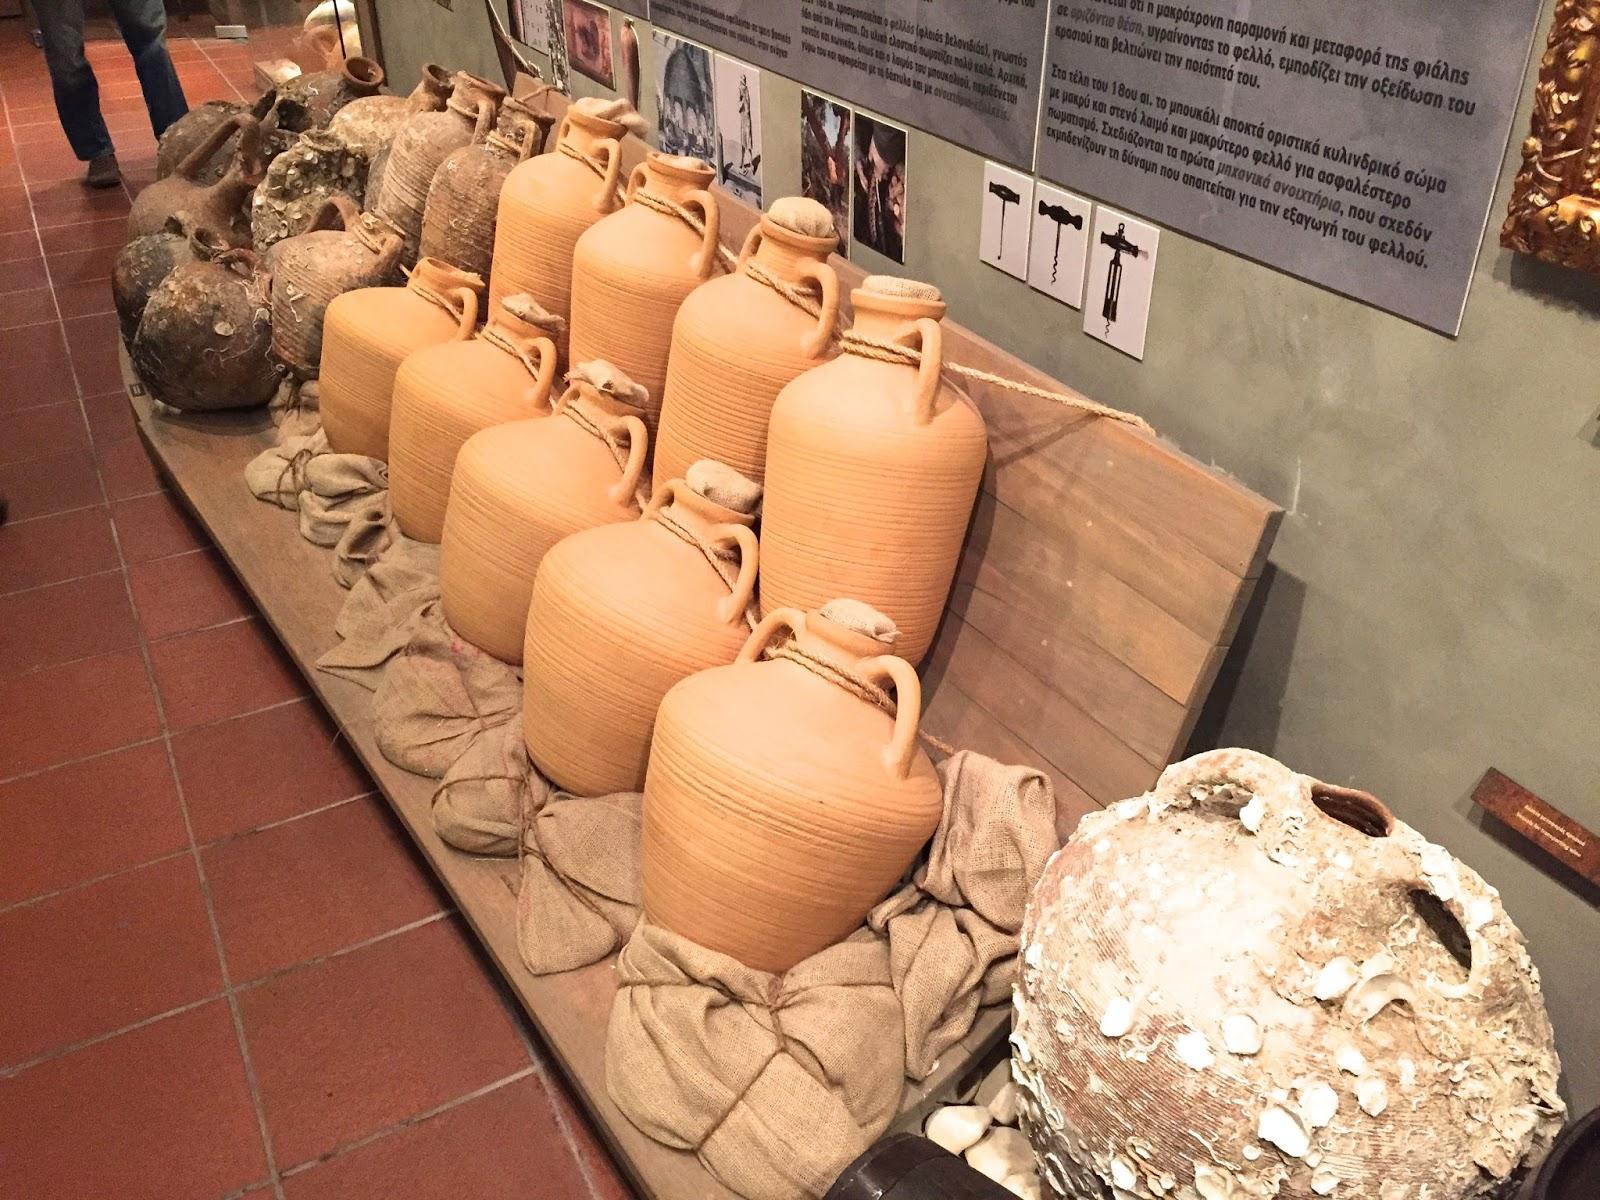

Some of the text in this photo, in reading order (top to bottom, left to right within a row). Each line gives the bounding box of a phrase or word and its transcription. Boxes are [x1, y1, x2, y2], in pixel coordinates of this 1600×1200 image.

[992, 48, 1028, 68] γνωστός
[1055, 25, 1260, 88] κρασιού και βελτιώνει την ποιότητά του.
[1057, 4, 1069, 17] σε
[1070, 8, 1115, 29] οριζόντια
[1117, 16, 1144, 37] θέση,
[1147, 25, 1214, 52] υγραίνοντας
[1217, 42, 1230, 56] το
[1233, 45, 1275, 68] φελλό,
[1279, 55, 1340, 83] εμποδίζει
[1344, 72, 1368, 90] την
[1372, 78, 1444, 108] οξείδωση
[1448, 98, 1476, 116] του
[1147, 2, 1154, 14] η
[1156, 3, 1224, 30] μακρόχρονη
[1227, 19, 1287, 43] παραμονή
[1290, 32, 1310, 49] και
[1313, 37, 1382, 66] μεταφορά
[1386, 53, 1409, 72] της
[1413, 59, 1470, 86] φιάλης
[1048, 106, 1433, 243] πωματισμό. Σχεδιάζονται τα πρώτα μηχανικά ανοιχτήρια, που σχεδόν
[1049, 87, 1412, 210] με μακρύ και στενό λαιμό και μακρύτερο φελλό για ασφαλέστερο
[1051, 64, 1448, 194] Στα τέλη του 18ου αι. το μπουκάλι αποκτά οριστικά κυλινδρικό σώμα
[1046, 126, 1428, 269] εκμηδενίζουν τη δύναμη που απαιτείται για την εξαγωγή του φελλού.
